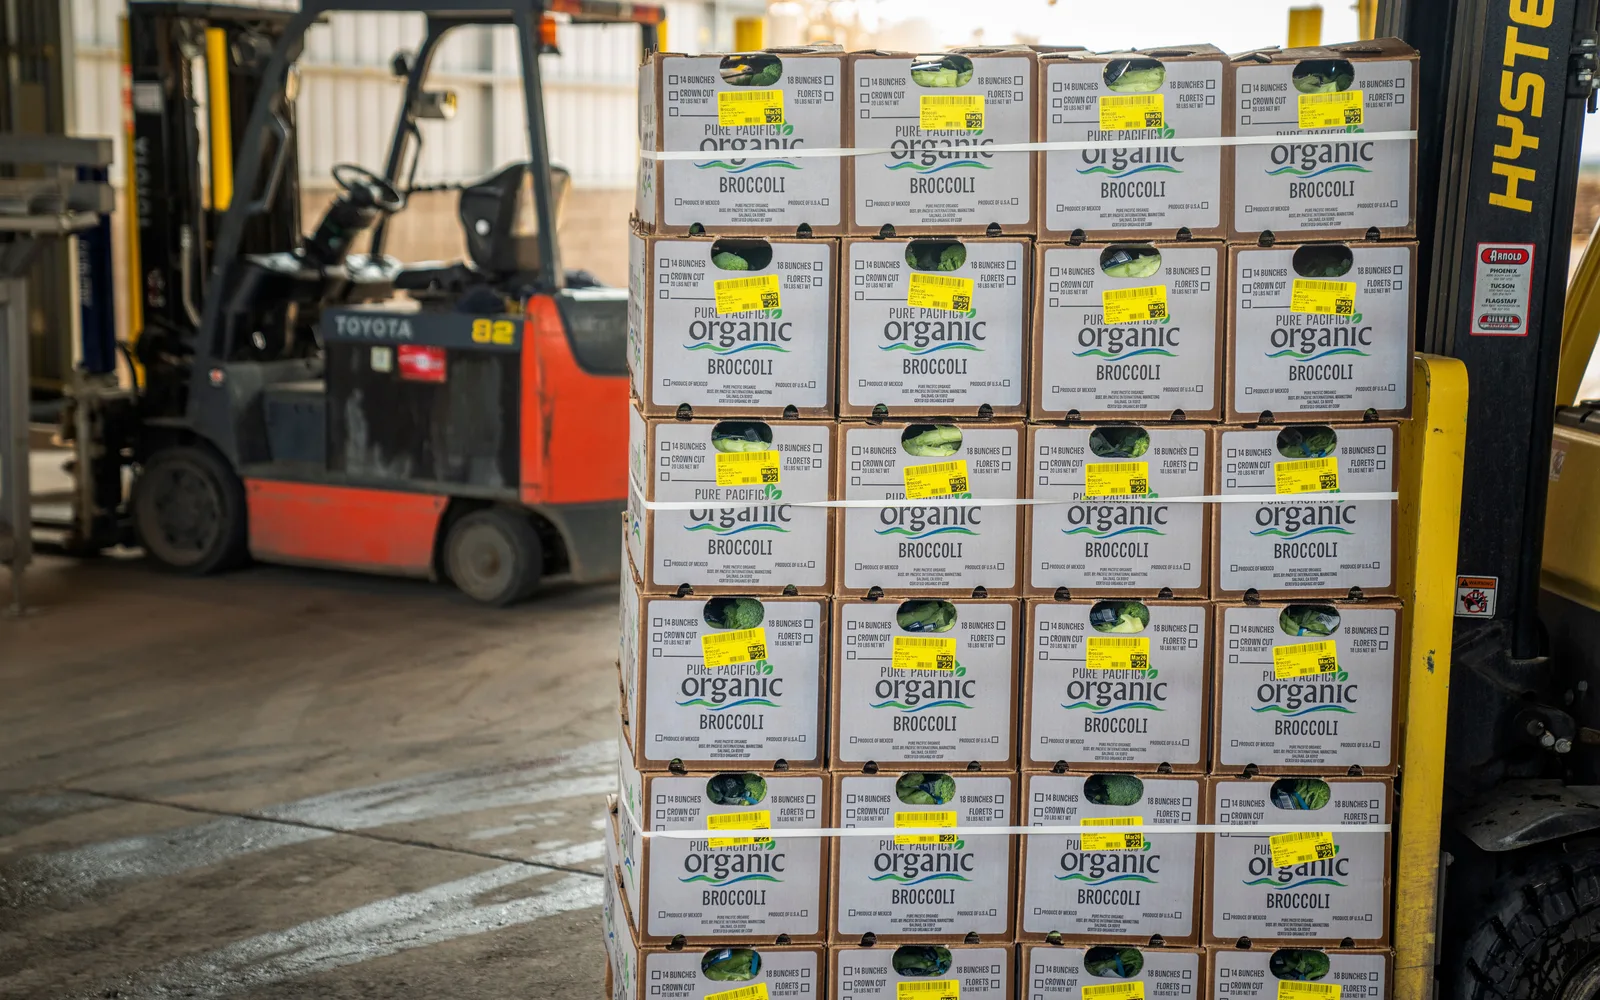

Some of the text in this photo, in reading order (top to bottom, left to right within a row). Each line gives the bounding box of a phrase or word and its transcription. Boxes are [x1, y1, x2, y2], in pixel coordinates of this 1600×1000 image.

[1261, 84, 1287, 92] BUNCHES
[705, 125, 775, 135] PURE PACIFIC
[1088, 129, 1156, 141] PURE PACIFIC
[1271, 141, 1374, 172] organic
[720, 177, 785, 193] BROCCOLI
[910, 177, 975, 193] BROCCOLI
[1101, 181, 1165, 198] BROCCOLI
[1290, 180, 1354, 198] BROCCOLI
[890, 308, 915, 318] PURE
[1276, 314, 1344, 325] PURE PACIFIC
[336, 317, 413, 339] TOYOTA
[472, 319, 515, 344] 82
[689, 320, 792, 348] organic
[884, 321, 986, 347] organic
[1078, 327, 1180, 354] organic
[1271, 326, 1372, 354] organic
[708, 359, 772, 375] BROCCOLI
[903, 359, 967, 374] BROCCOLI
[1097, 365, 1160, 380] BROCCOLI
[1290, 364, 1353, 381] BROCCOLI
[695, 489, 764, 500] PURE PACIFIC
[1067, 505, 1168, 531] organic
[1256, 505, 1356, 533] organic
[709, 539, 772, 555] BROCCOLI
[899, 543, 962, 558] BROCCOLI
[1086, 542, 1148, 557] BROCCOLI
[1274, 542, 1337, 558] BROCCOLI
[687, 665, 755, 675] PURE PACIFIC
[881, 668, 906, 677] PURE
[1073, 668, 1140, 679] PURE PACIFIC
[681, 677, 783, 703] organic
[875, 679, 976, 705] organic
[1067, 680, 1167, 707] organic
[1257, 683, 1358, 710] organic
[700, 714, 763, 729] BROCCOLI
[894, 716, 956, 731] BROCCOLI
[1085, 717, 1148, 733] BROCCOLI
[1275, 720, 1338, 735] BROCCOLI
[880, 841, 904, 850] PURE
[684, 853, 785, 879] organic
[874, 853, 974, 878] organic
[1060, 852, 1160, 880] organic
[703, 890, 766, 905] BROCCOLI
[892, 889, 955, 904] BROCCOLI
[1078, 889, 1140, 905] BROCCOLI
[1267, 894, 1330, 908] BROCCOLI
